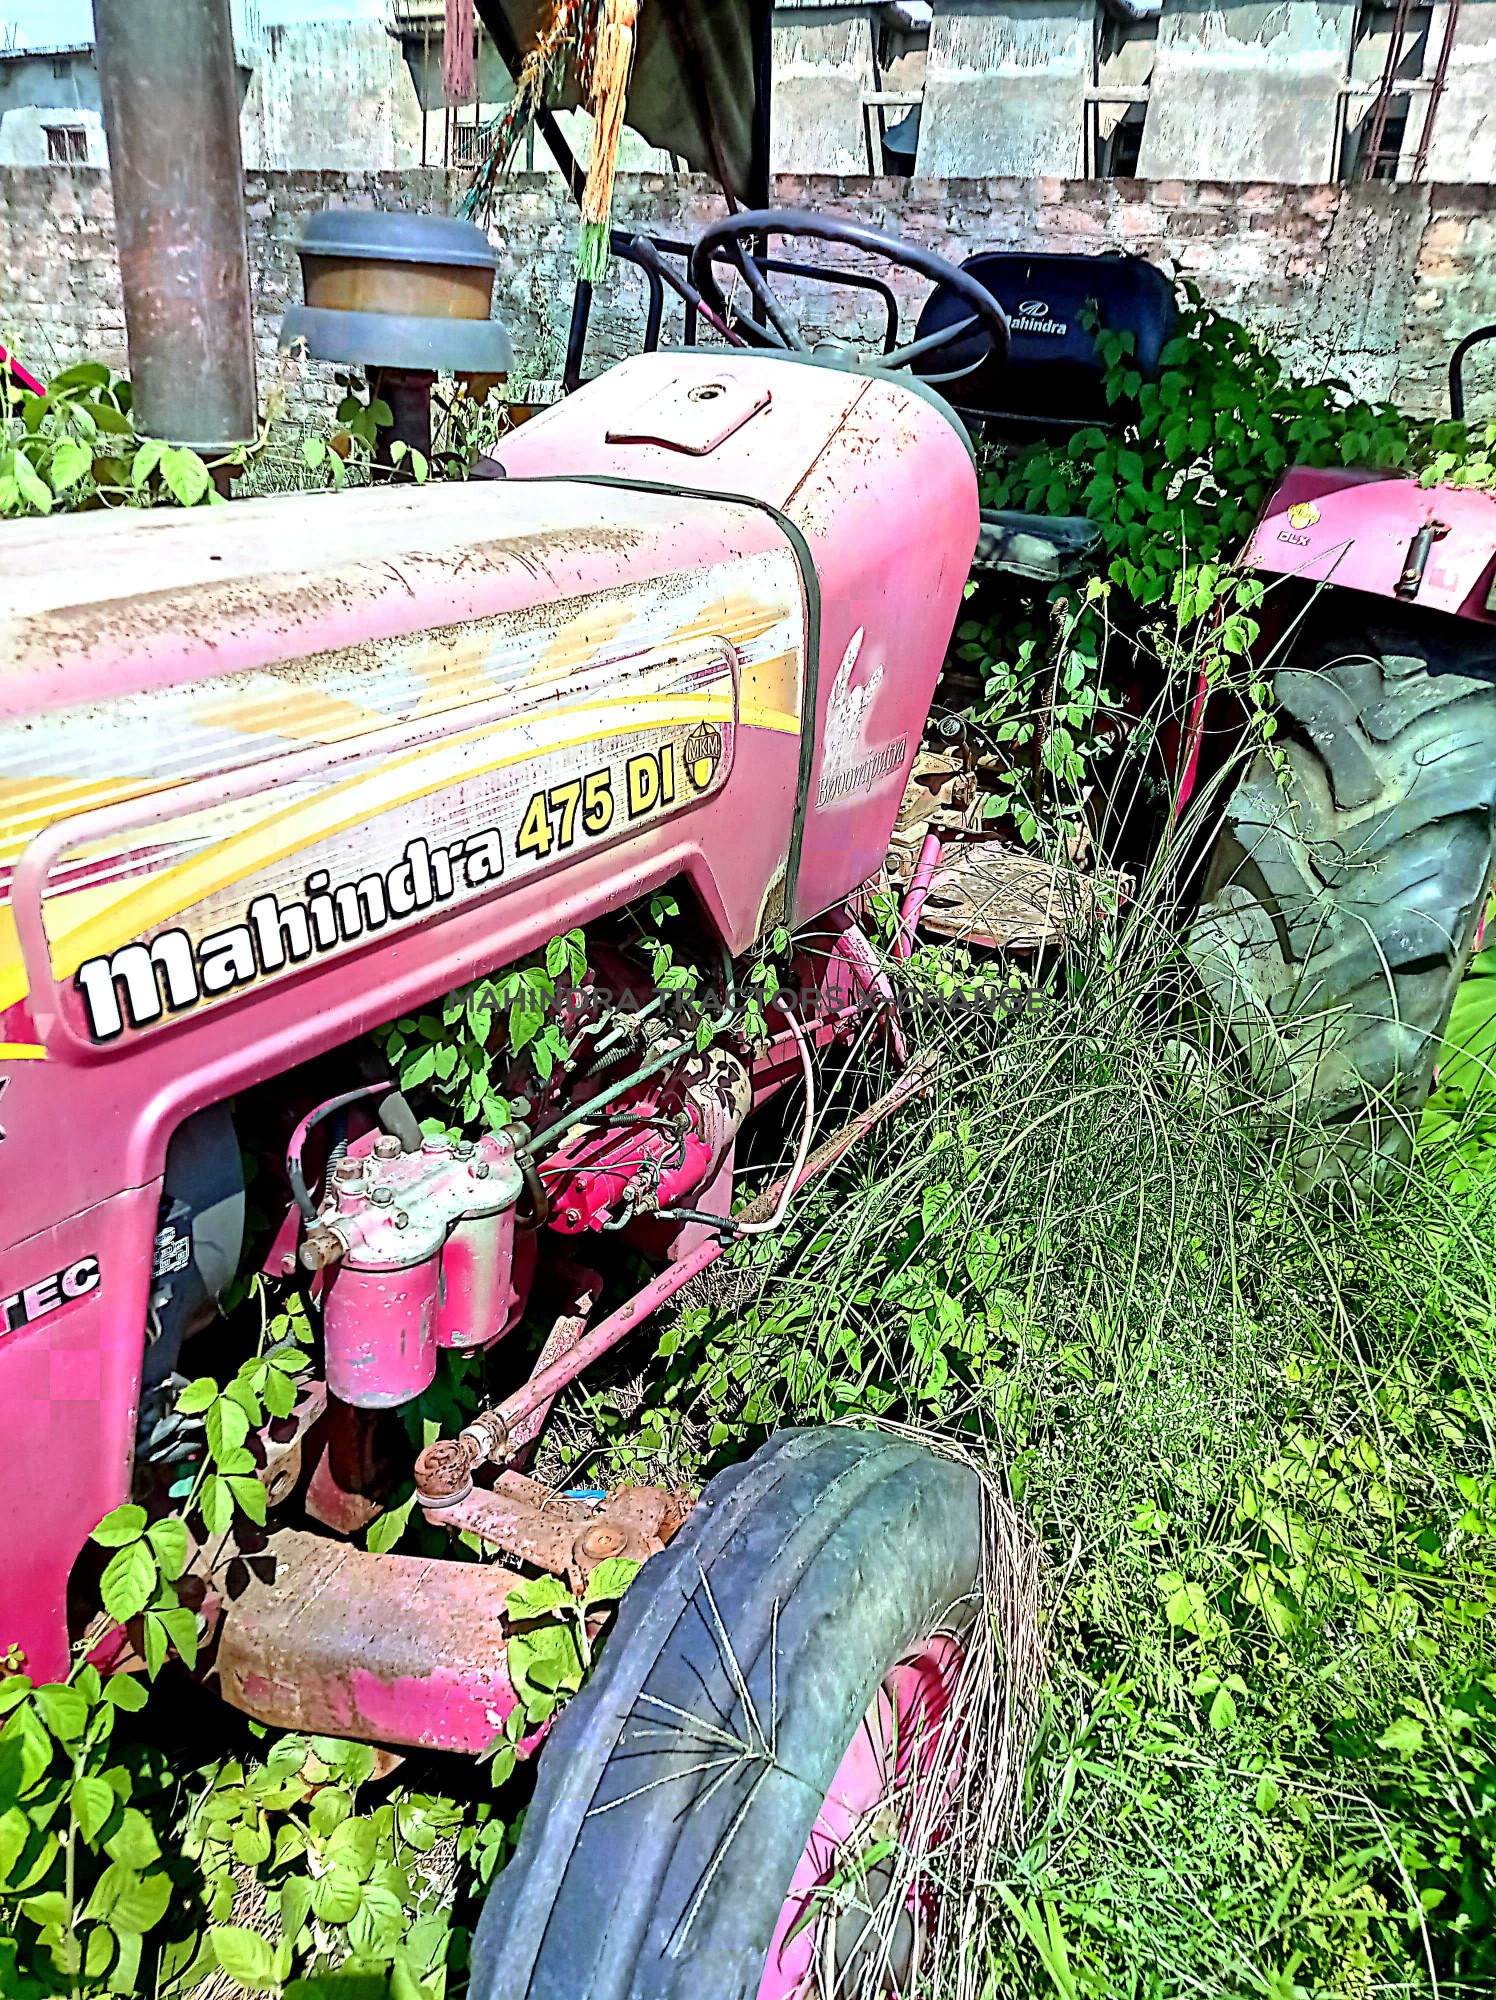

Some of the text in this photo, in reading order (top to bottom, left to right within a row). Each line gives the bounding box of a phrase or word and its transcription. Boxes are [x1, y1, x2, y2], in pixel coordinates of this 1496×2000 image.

[1277, 530, 1311, 546] DLX
[687, 734, 719, 762] MKM
[75, 743, 675, 1044] Mahindra 475 DI
